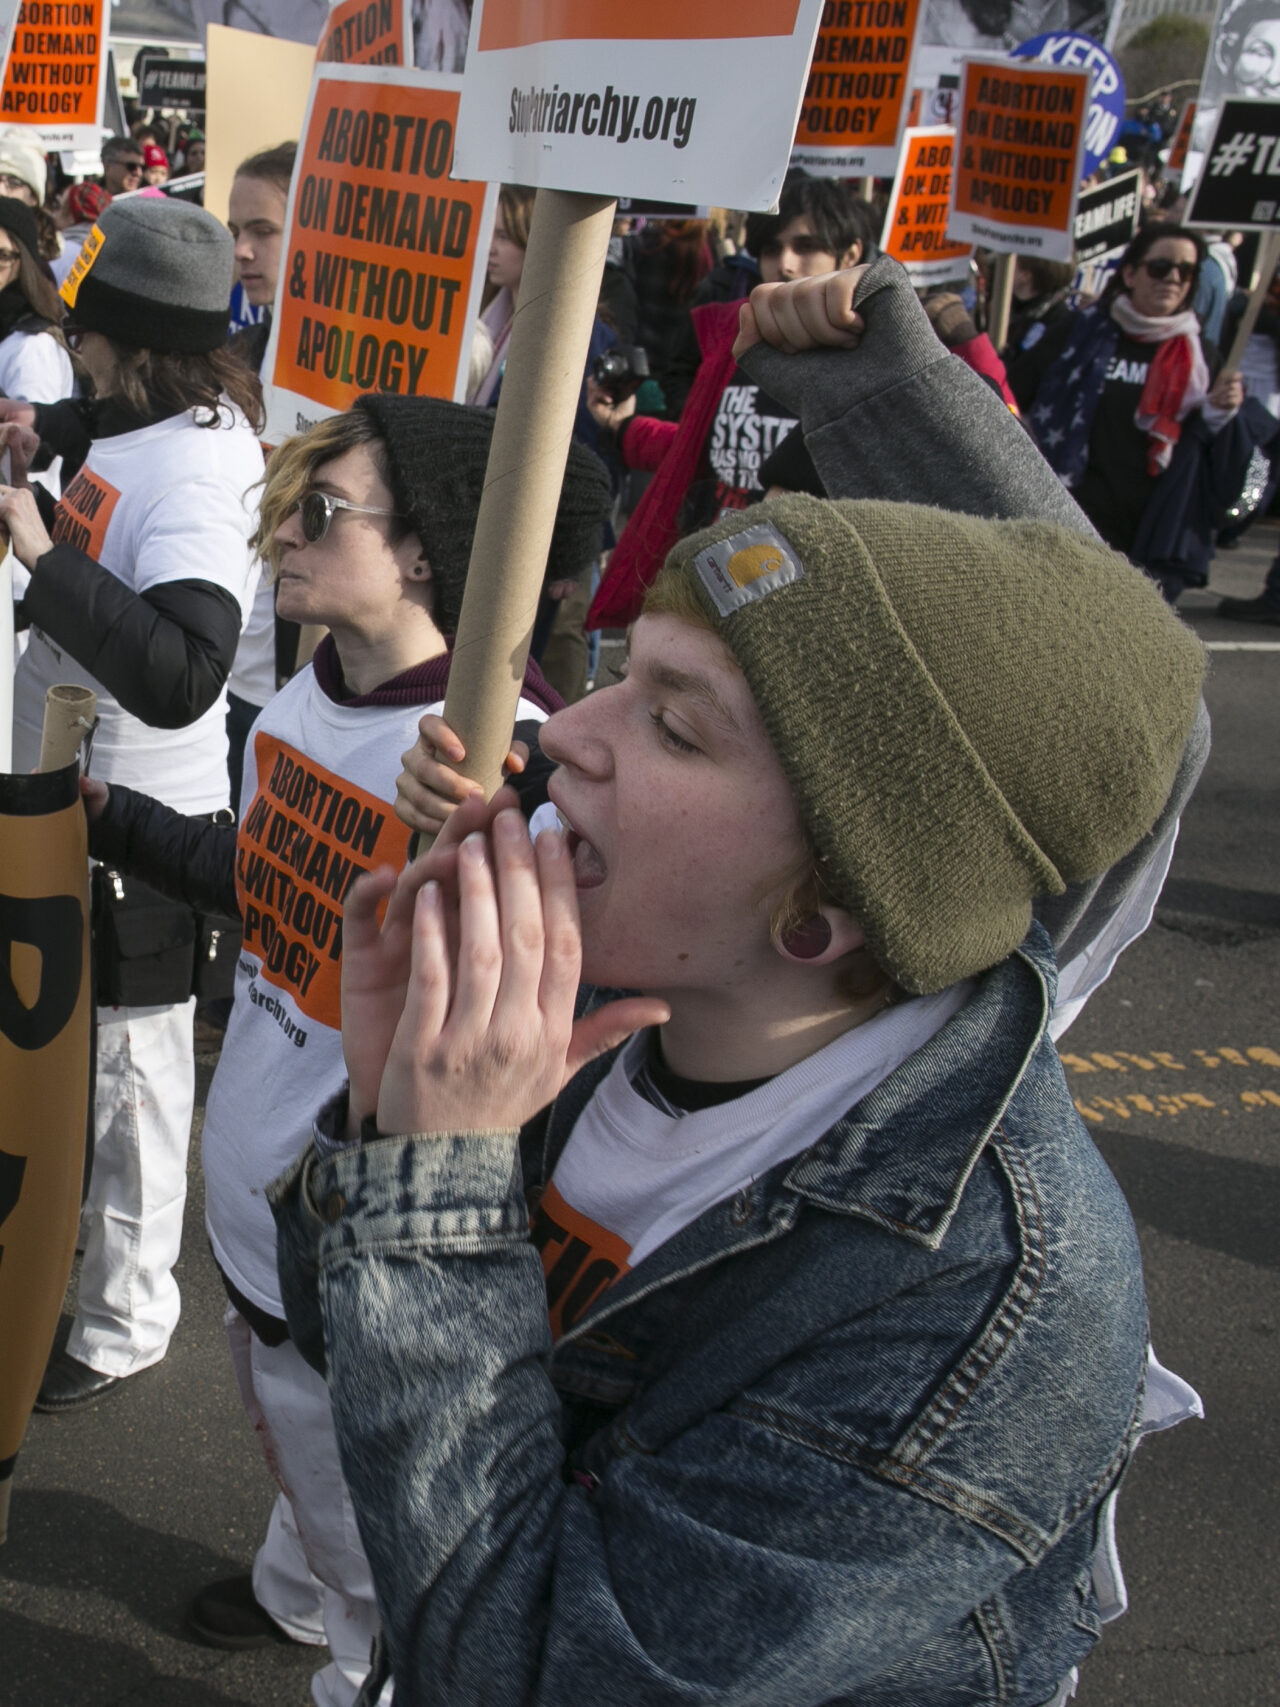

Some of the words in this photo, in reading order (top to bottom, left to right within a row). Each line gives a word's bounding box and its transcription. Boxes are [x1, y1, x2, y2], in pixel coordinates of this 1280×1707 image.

[23, 33, 97, 56] DEMAND
[12, 62, 96, 85] WITHOUT
[1, 89, 83, 114] APOLOGY
[977, 76, 1077, 114] ABORTION
[317, 106, 460, 181] ABORTIO
[966, 109, 988, 138] ON
[991, 112, 1076, 150] DEMAND
[979, 147, 1070, 185] WITHOUT
[298, 173, 333, 233] ON
[332, 180, 474, 260] DEMAND
[970, 177, 1055, 216] APOLOGY
[289, 249, 308, 301] &
[313, 250, 462, 337] WITHOUT
[295, 315, 430, 396] APOLOGY
[719, 384, 760, 414] THE
[245, 794, 270, 841] ON
[267, 750, 387, 858] ABORTION
[244, 848, 343, 963] WITHOUT
